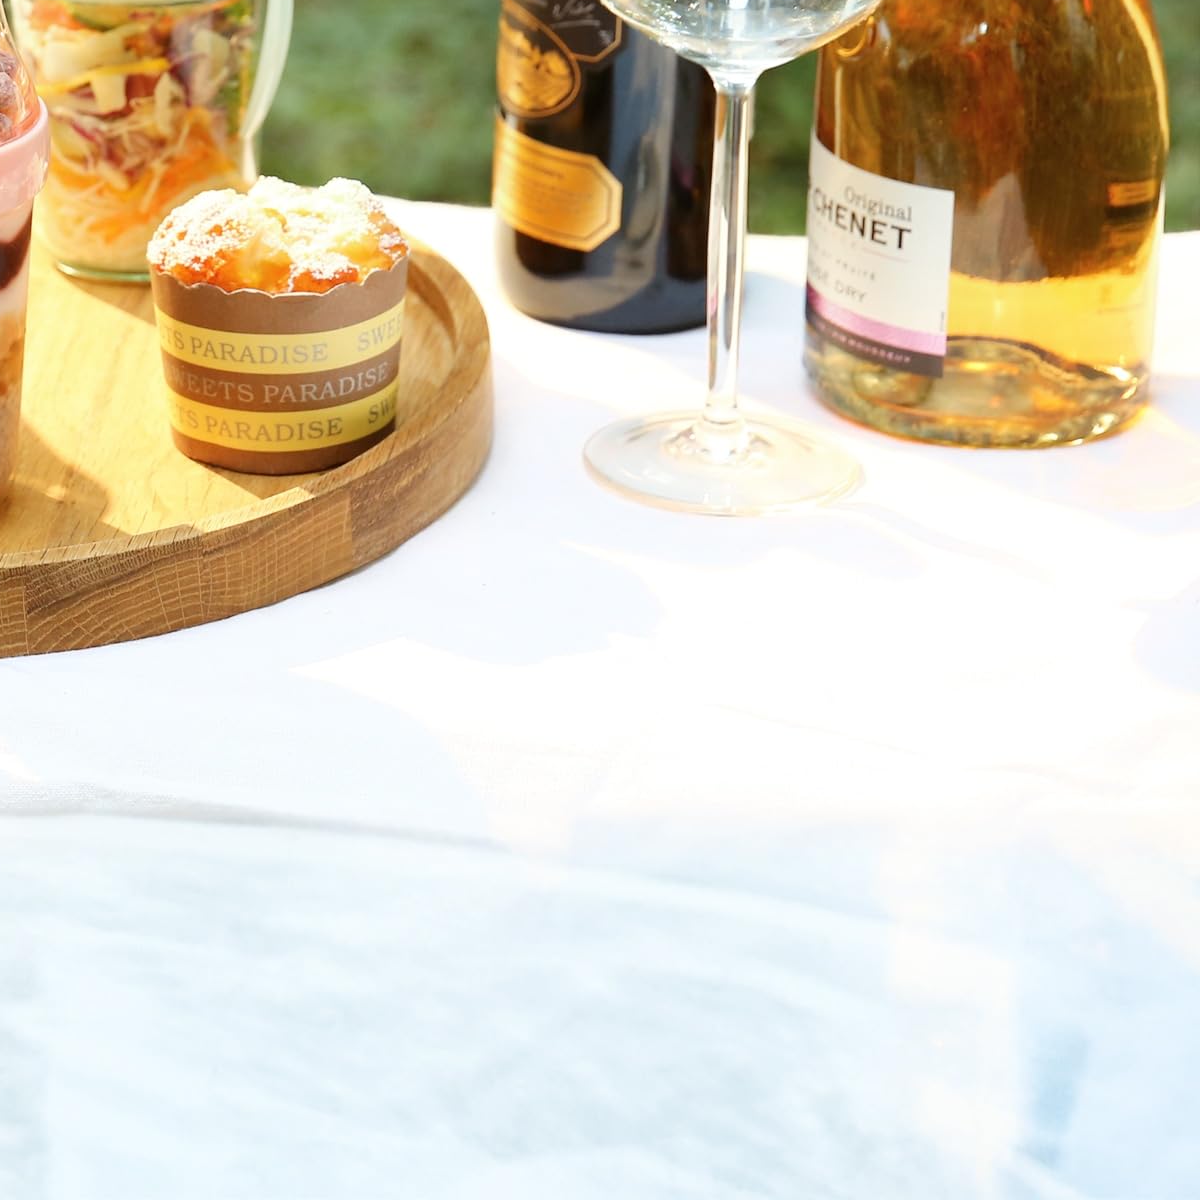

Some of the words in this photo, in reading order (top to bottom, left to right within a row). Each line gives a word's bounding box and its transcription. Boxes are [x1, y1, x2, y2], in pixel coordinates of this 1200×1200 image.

[813, 187, 912, 248] CHENET
[844, 185, 913, 222] Original
[190, 335, 329, 365] PARADISE
[263, 361, 389, 404] PARADISE
[205, 415, 343, 443] PARADISE
